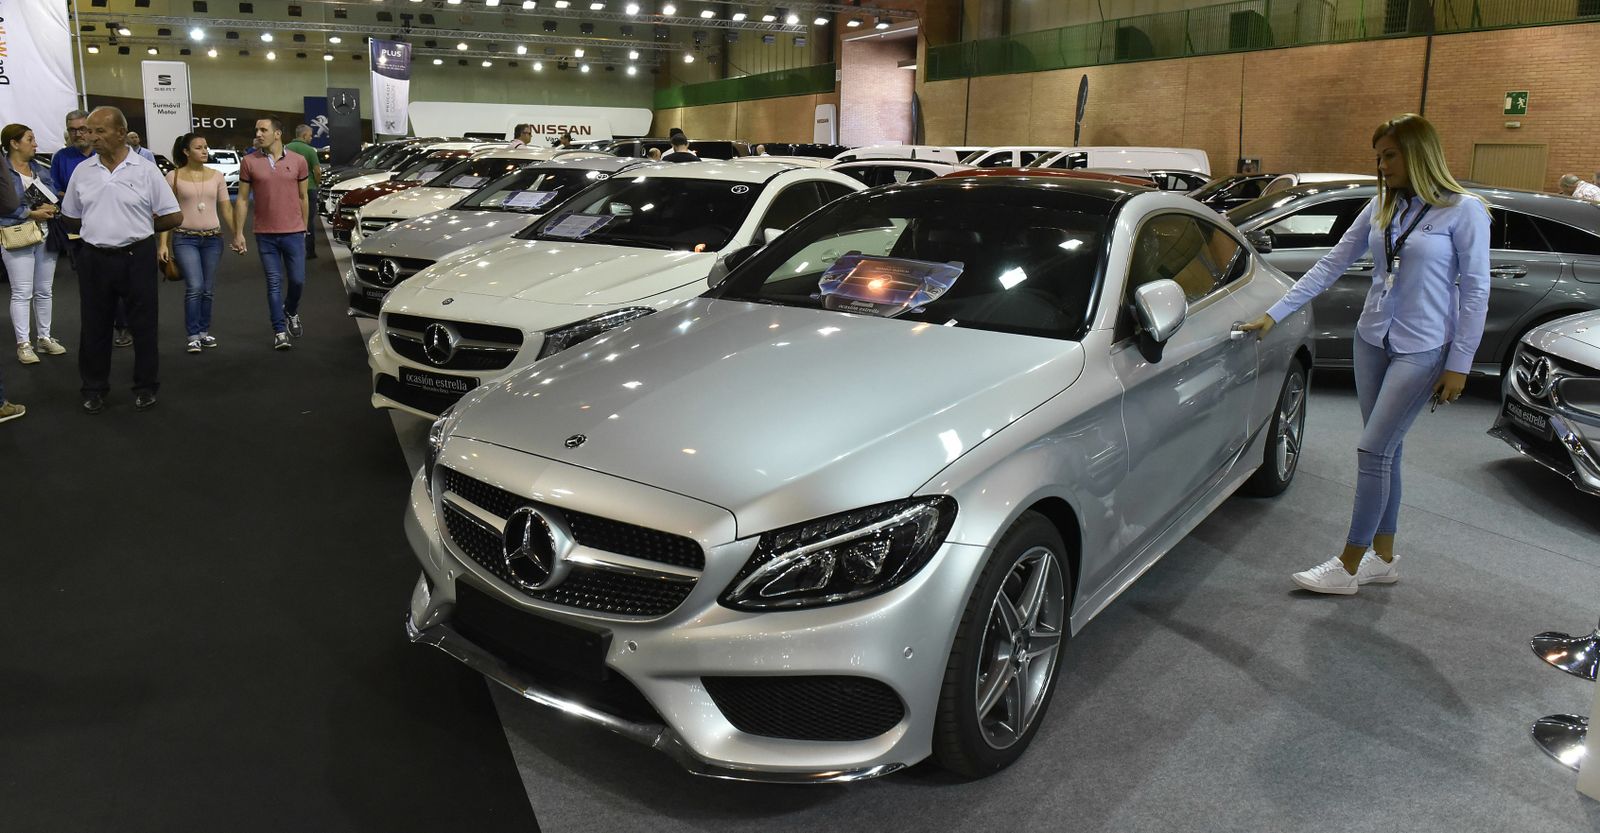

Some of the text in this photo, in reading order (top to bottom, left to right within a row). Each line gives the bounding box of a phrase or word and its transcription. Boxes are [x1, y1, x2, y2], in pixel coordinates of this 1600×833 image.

[381, 49, 401, 57] PLUS
[192, 117, 236, 129] GEOT
[530, 124, 591, 135] NISSAN
[405, 373, 468, 391] ocasión estrella
[1522, 411, 1546, 428] estrella
